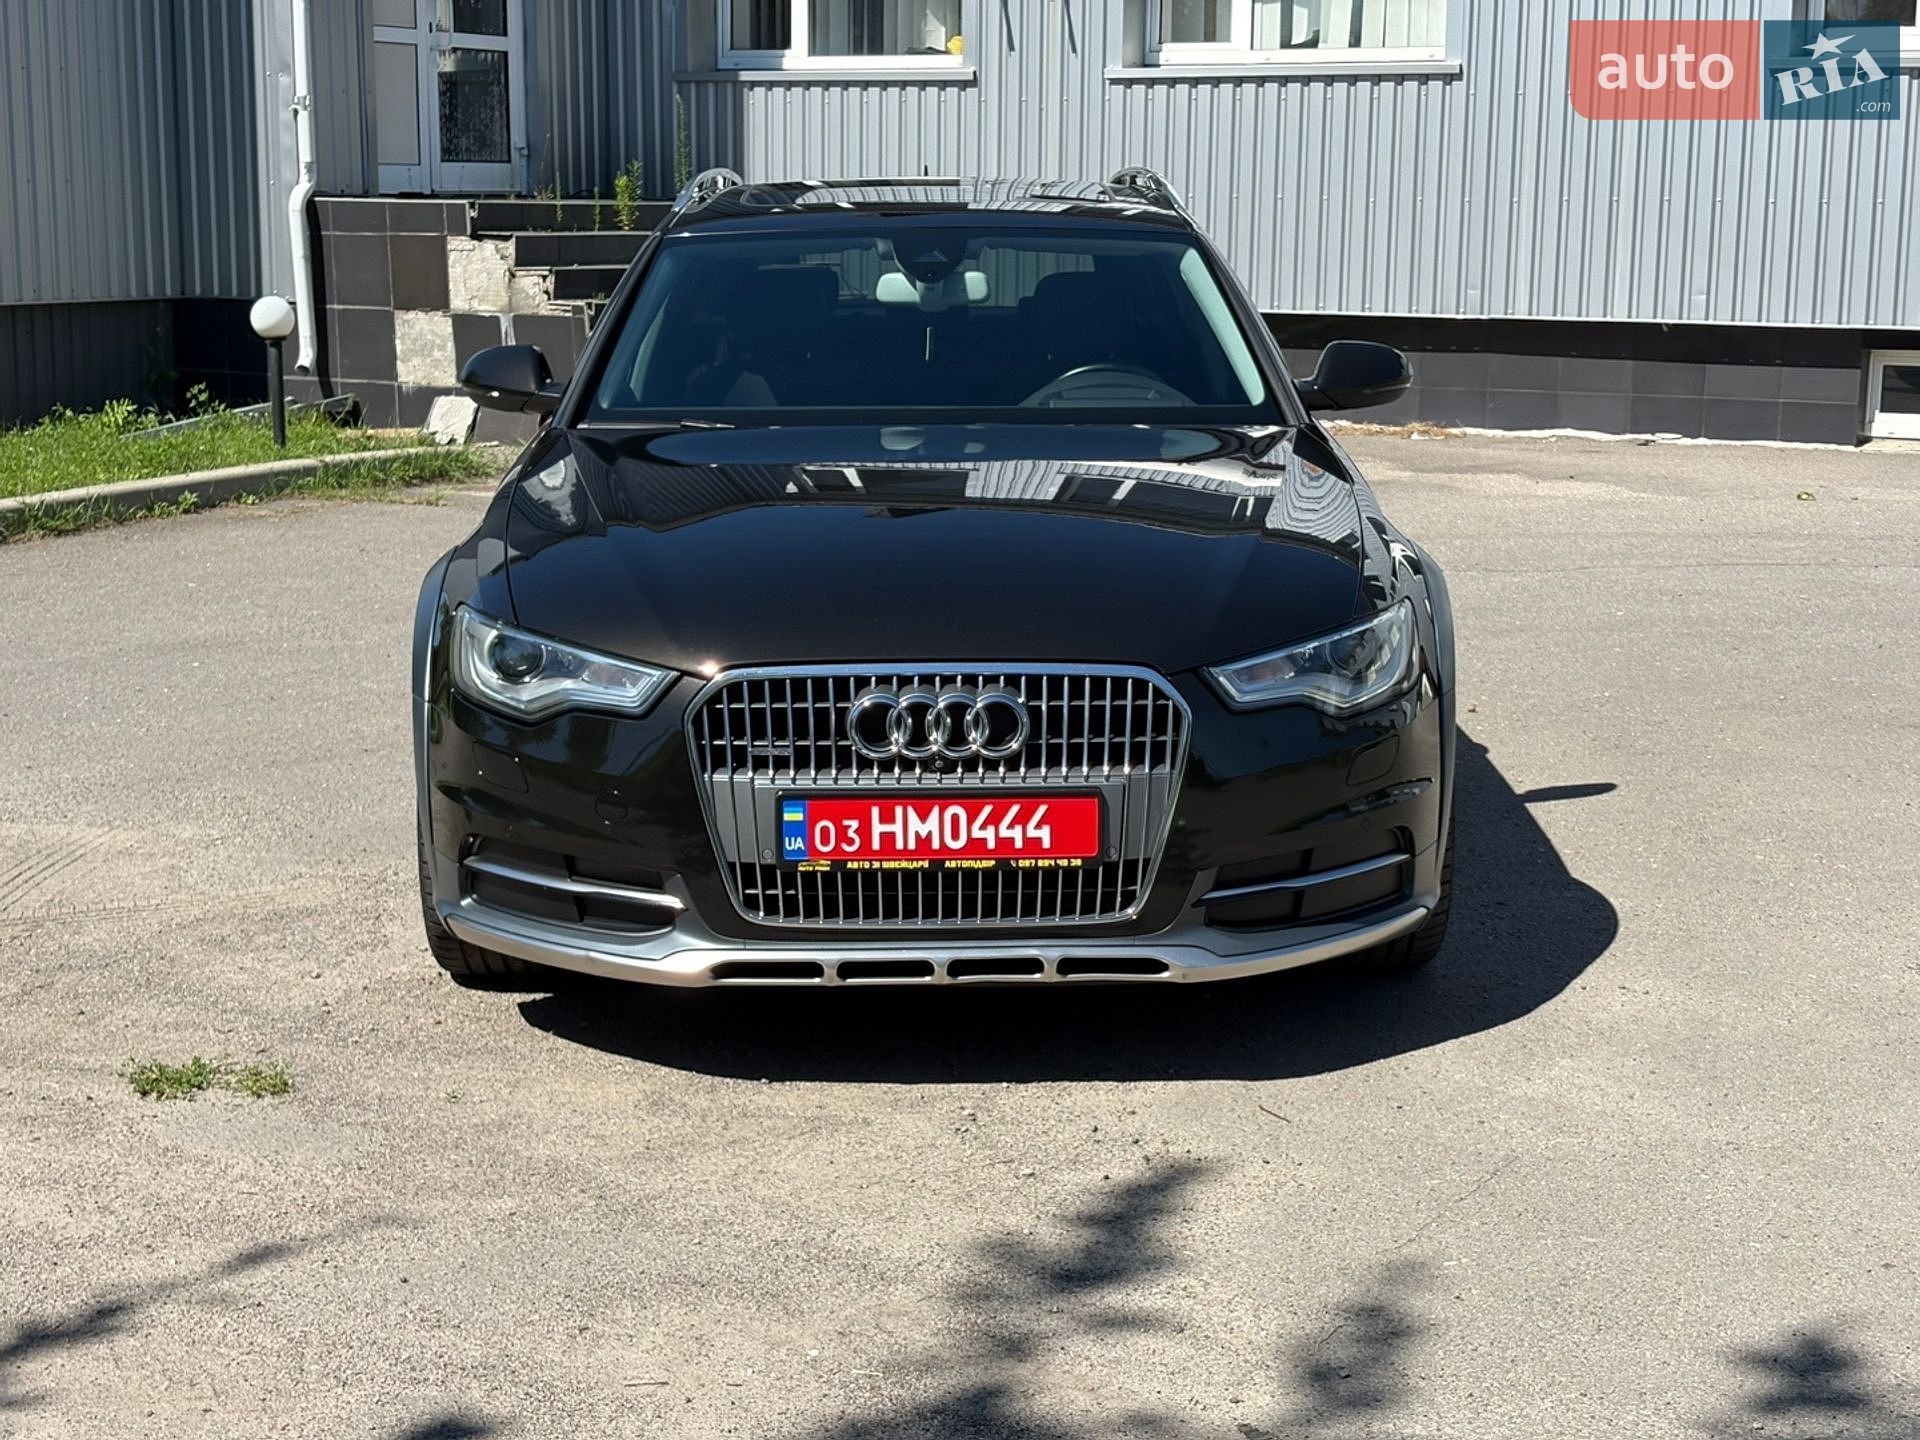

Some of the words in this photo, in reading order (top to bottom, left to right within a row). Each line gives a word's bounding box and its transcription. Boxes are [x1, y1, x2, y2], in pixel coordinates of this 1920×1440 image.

[785, 837, 805, 850] UA
[814, 820, 861, 853] 03
[871, 804, 1051, 851] HM0444
[846, 859, 870, 869] АВТО
